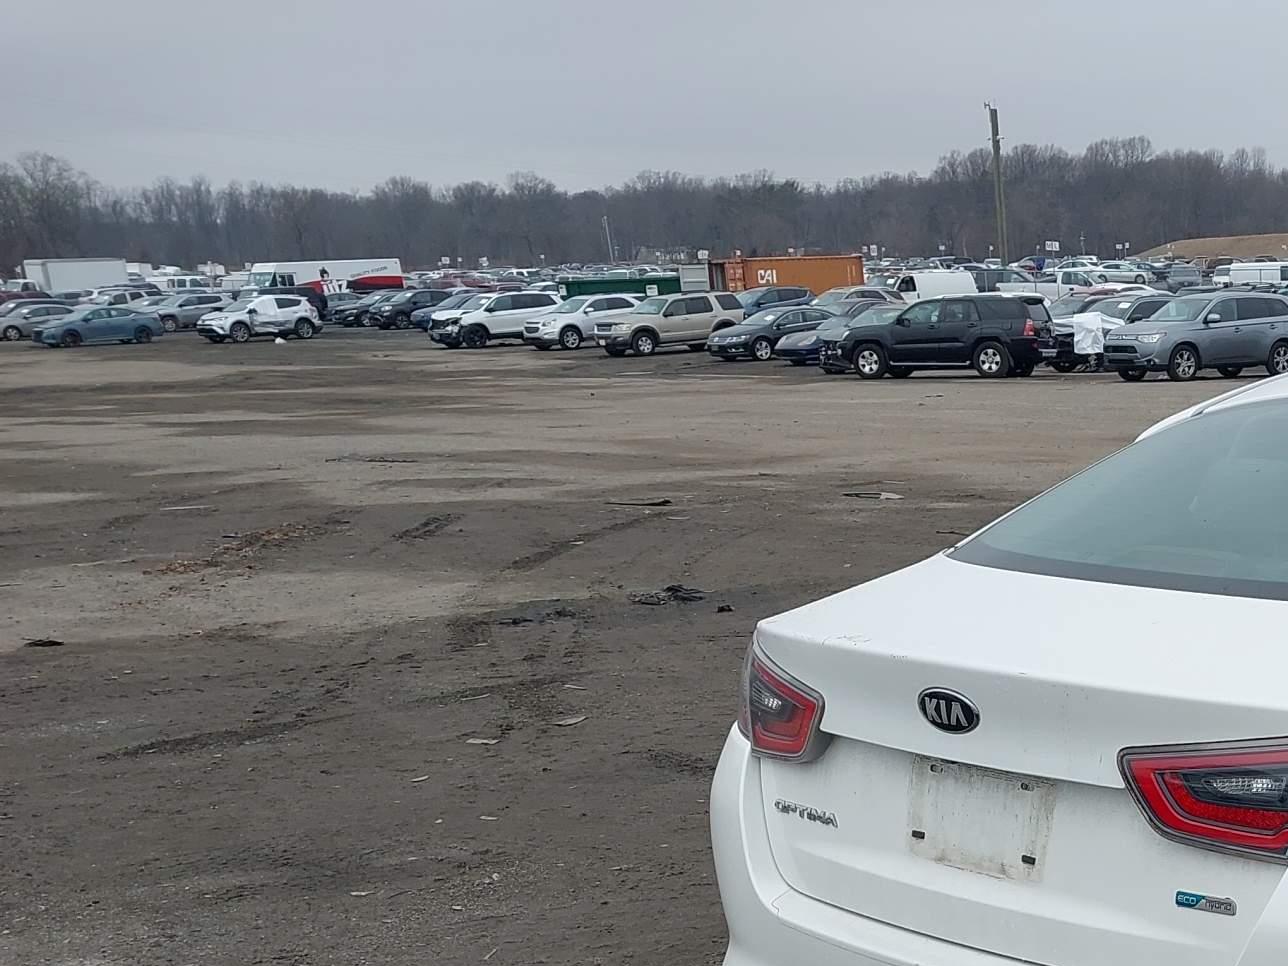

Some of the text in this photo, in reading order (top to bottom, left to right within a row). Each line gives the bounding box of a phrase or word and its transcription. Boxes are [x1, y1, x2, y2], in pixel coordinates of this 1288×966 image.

[757, 269, 777, 284] CAI
[924, 697, 968, 726] KIA
[774, 799, 838, 828] OPTIMA
[1177, 894, 1197, 905] ECO
